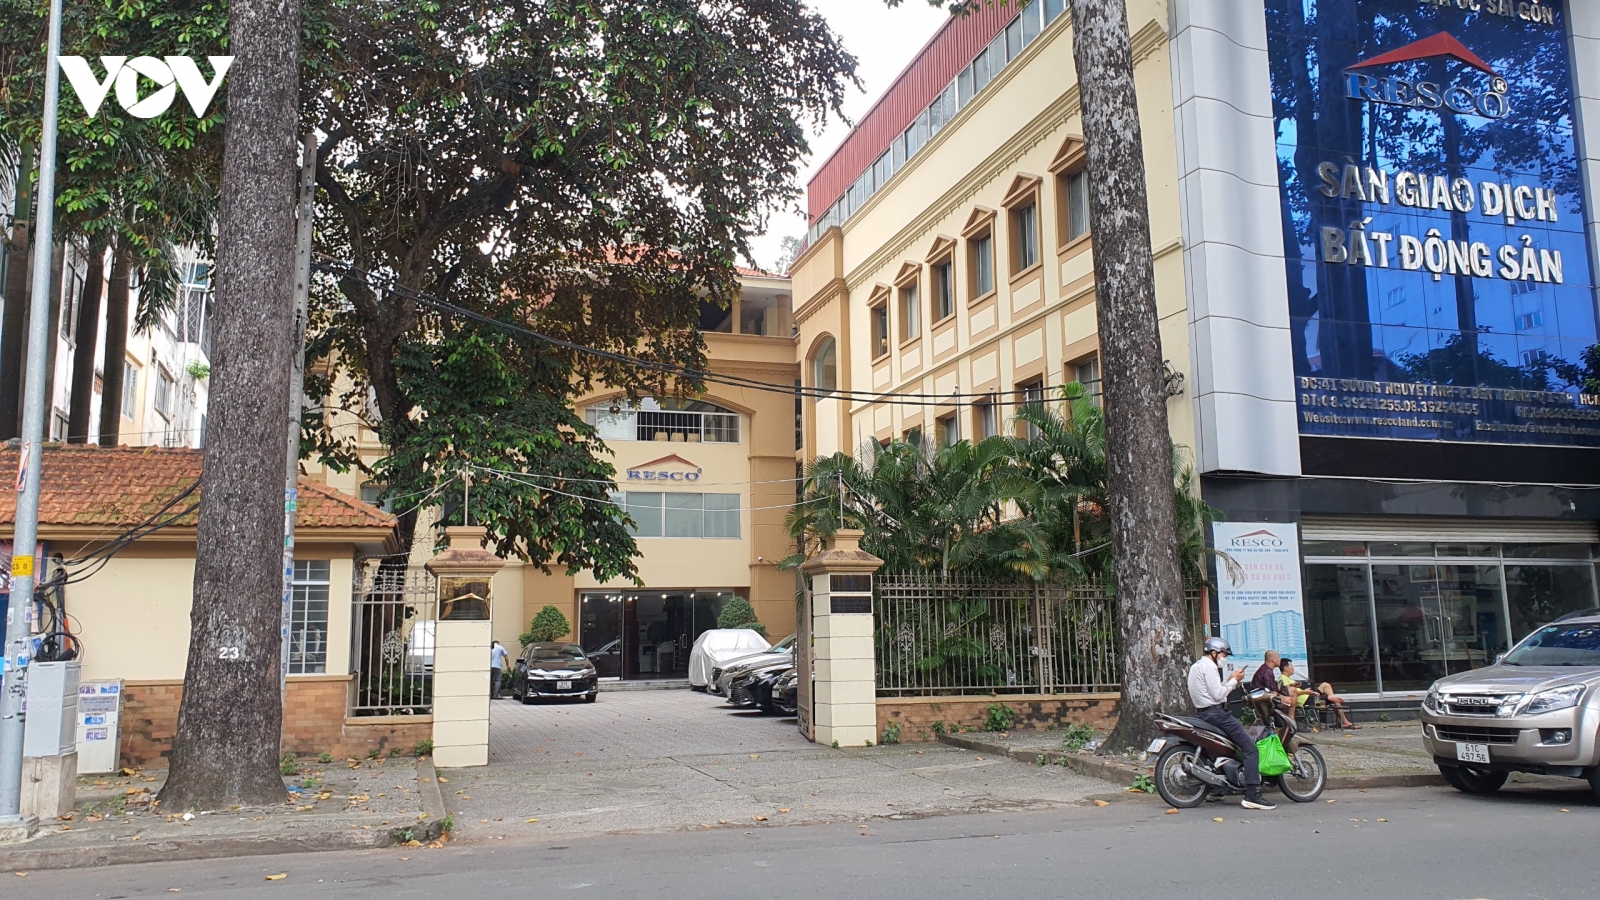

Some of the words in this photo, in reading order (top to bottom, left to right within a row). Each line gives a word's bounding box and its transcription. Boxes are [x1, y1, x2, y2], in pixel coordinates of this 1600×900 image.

[1343, 71, 1510, 119] RESCO
[1317, 157, 1390, 204] SÀN
[1395, 171, 1475, 213] GIAO
[1481, 181, 1558, 226] DỊCH
[1321, 217, 1392, 268] BẤT
[1398, 228, 1493, 282] ĐỘNG
[1499, 234, 1564, 284] SẢN
[626, 470, 699, 481] RESCO
[1231, 539, 1283, 547] RESCO
[1169, 631, 1182, 641] 25
[219, 647, 239, 659] 23
[1465, 743, 1480, 753] 61C
